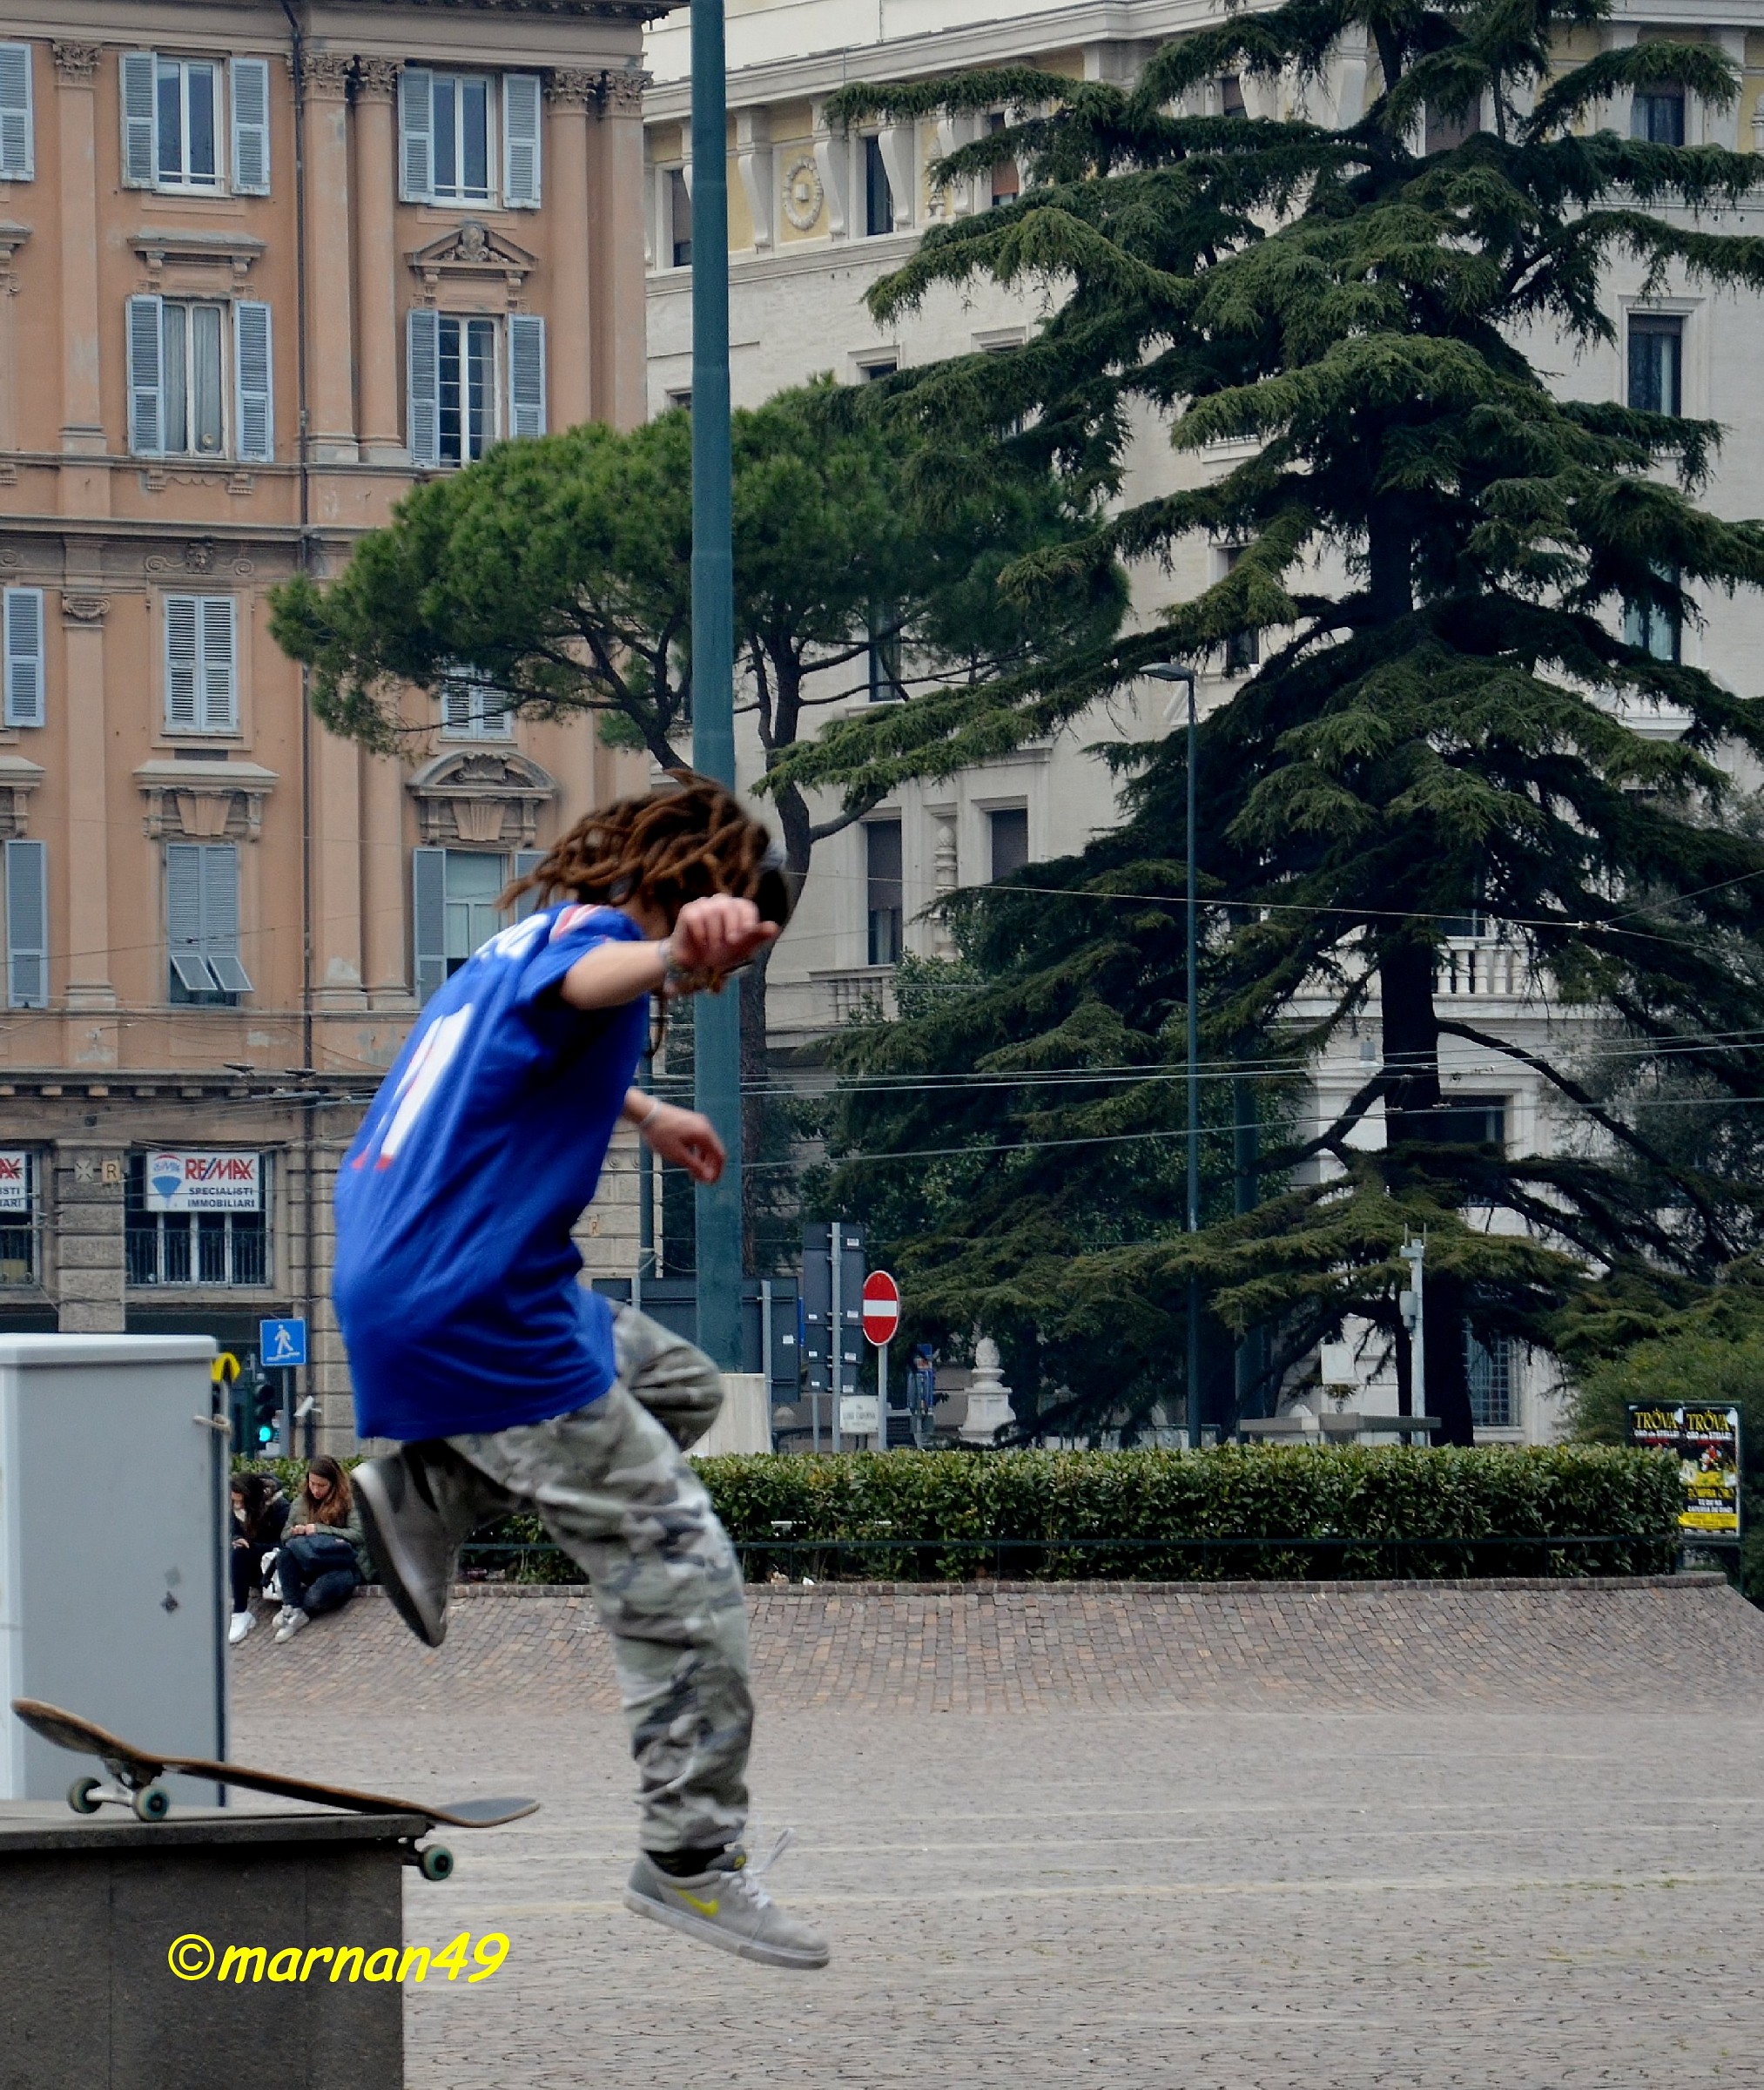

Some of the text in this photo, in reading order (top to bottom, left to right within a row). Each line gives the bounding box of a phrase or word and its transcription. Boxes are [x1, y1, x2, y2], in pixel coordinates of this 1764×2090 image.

[106, 1163, 118, 1179] R
[185, 1157, 254, 1181] RE/MAX
[188, 1187, 253, 1196] SPECIALISTI
[187, 1198, 255, 1208] IMMOBILIARI
